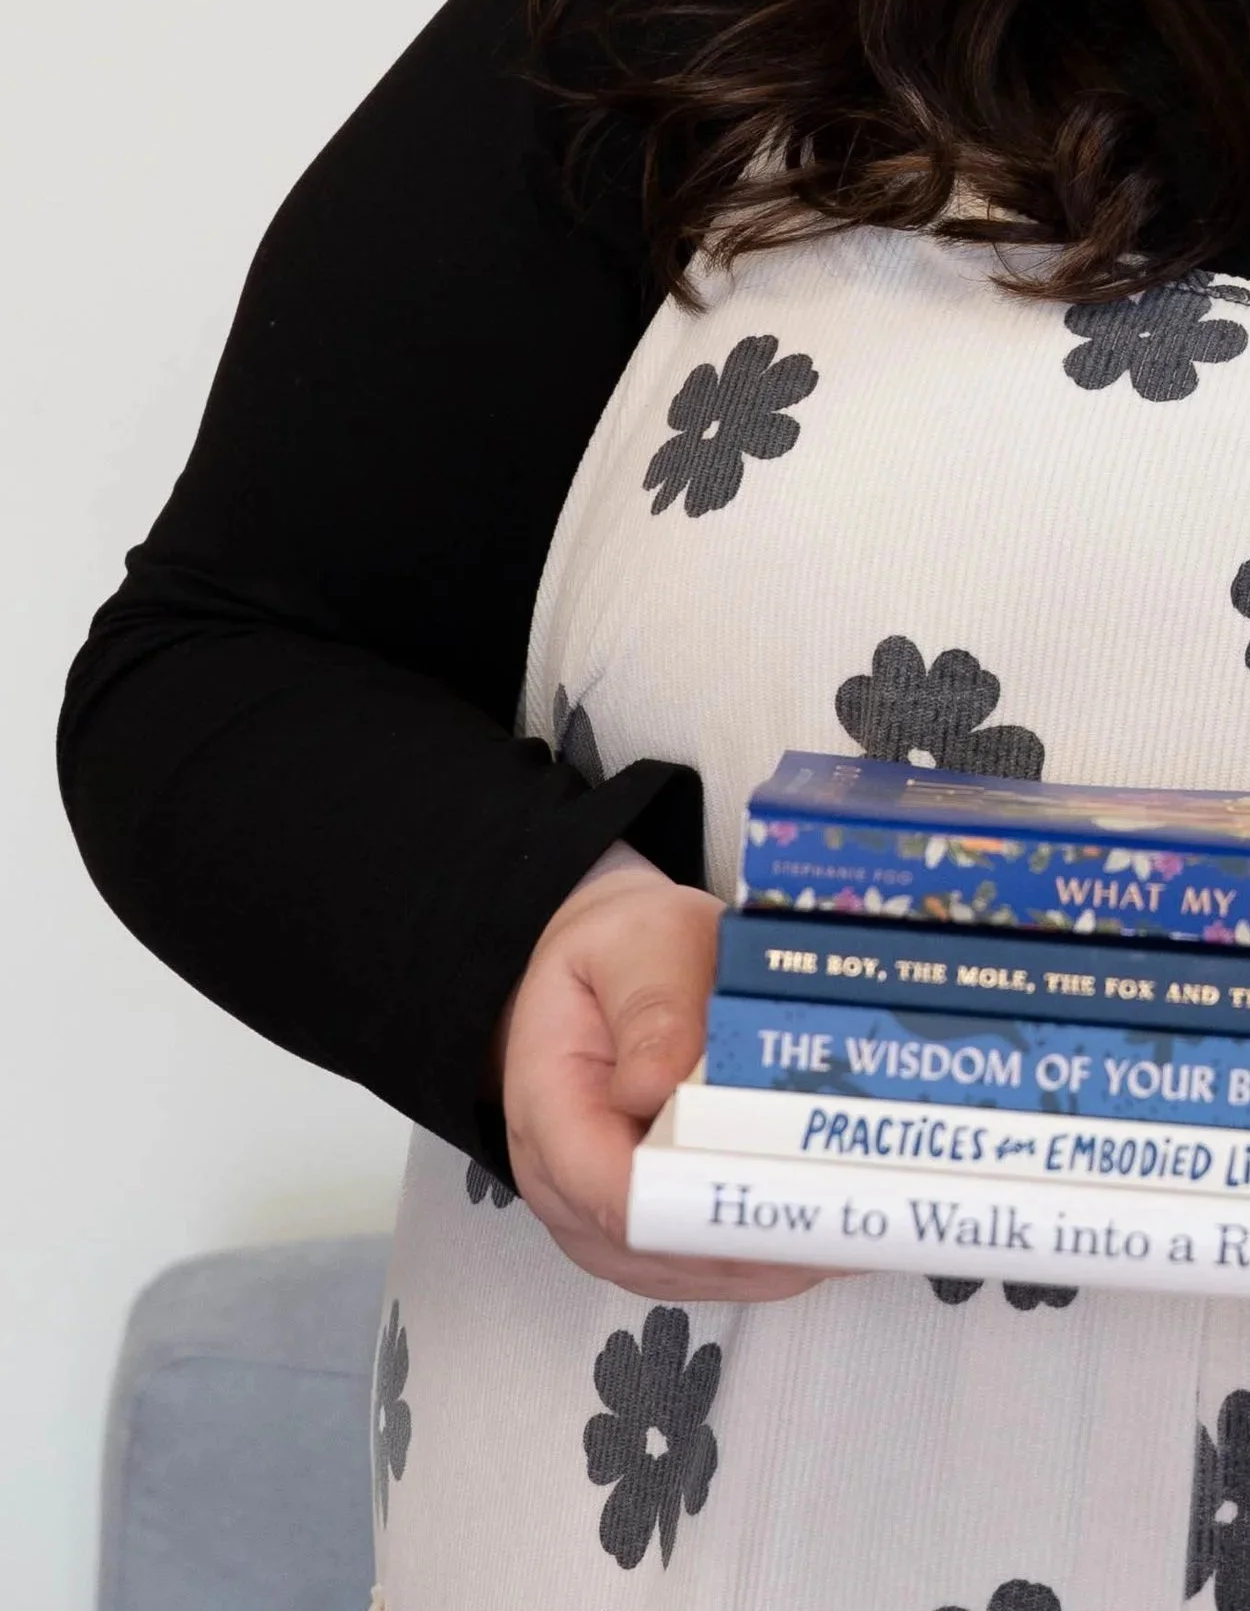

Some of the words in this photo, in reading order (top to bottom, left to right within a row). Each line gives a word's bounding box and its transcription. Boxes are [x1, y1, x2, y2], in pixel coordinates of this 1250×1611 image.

[1055, 876, 1166, 912] WHAT
[1181, 889, 1237, 918] MY
[765, 949, 817, 974] THE
[826, 953, 888, 982] BOY,
[895, 959, 947, 984] THE
[957, 965, 1036, 994] MOLE,
[1044, 972, 1096, 996] THE
[1104, 978, 1155, 1001] FOX
[1165, 983, 1220, 1006] AND
[758, 1029, 833, 1073] THE
[844, 1037, 1023, 1088] WISDOM
[1035, 1053, 1091, 1092] OF
[1104, 1058, 1216, 1102] YOUR
[995, 1133, 1037, 1161] for
[709, 1181, 822, 1233] How
[841, 1195, 889, 1240] to
[909, 1199, 1036, 1250] Walk
[1052, 1211, 1151, 1262] into
[1167, 1230, 1196, 1265] a
